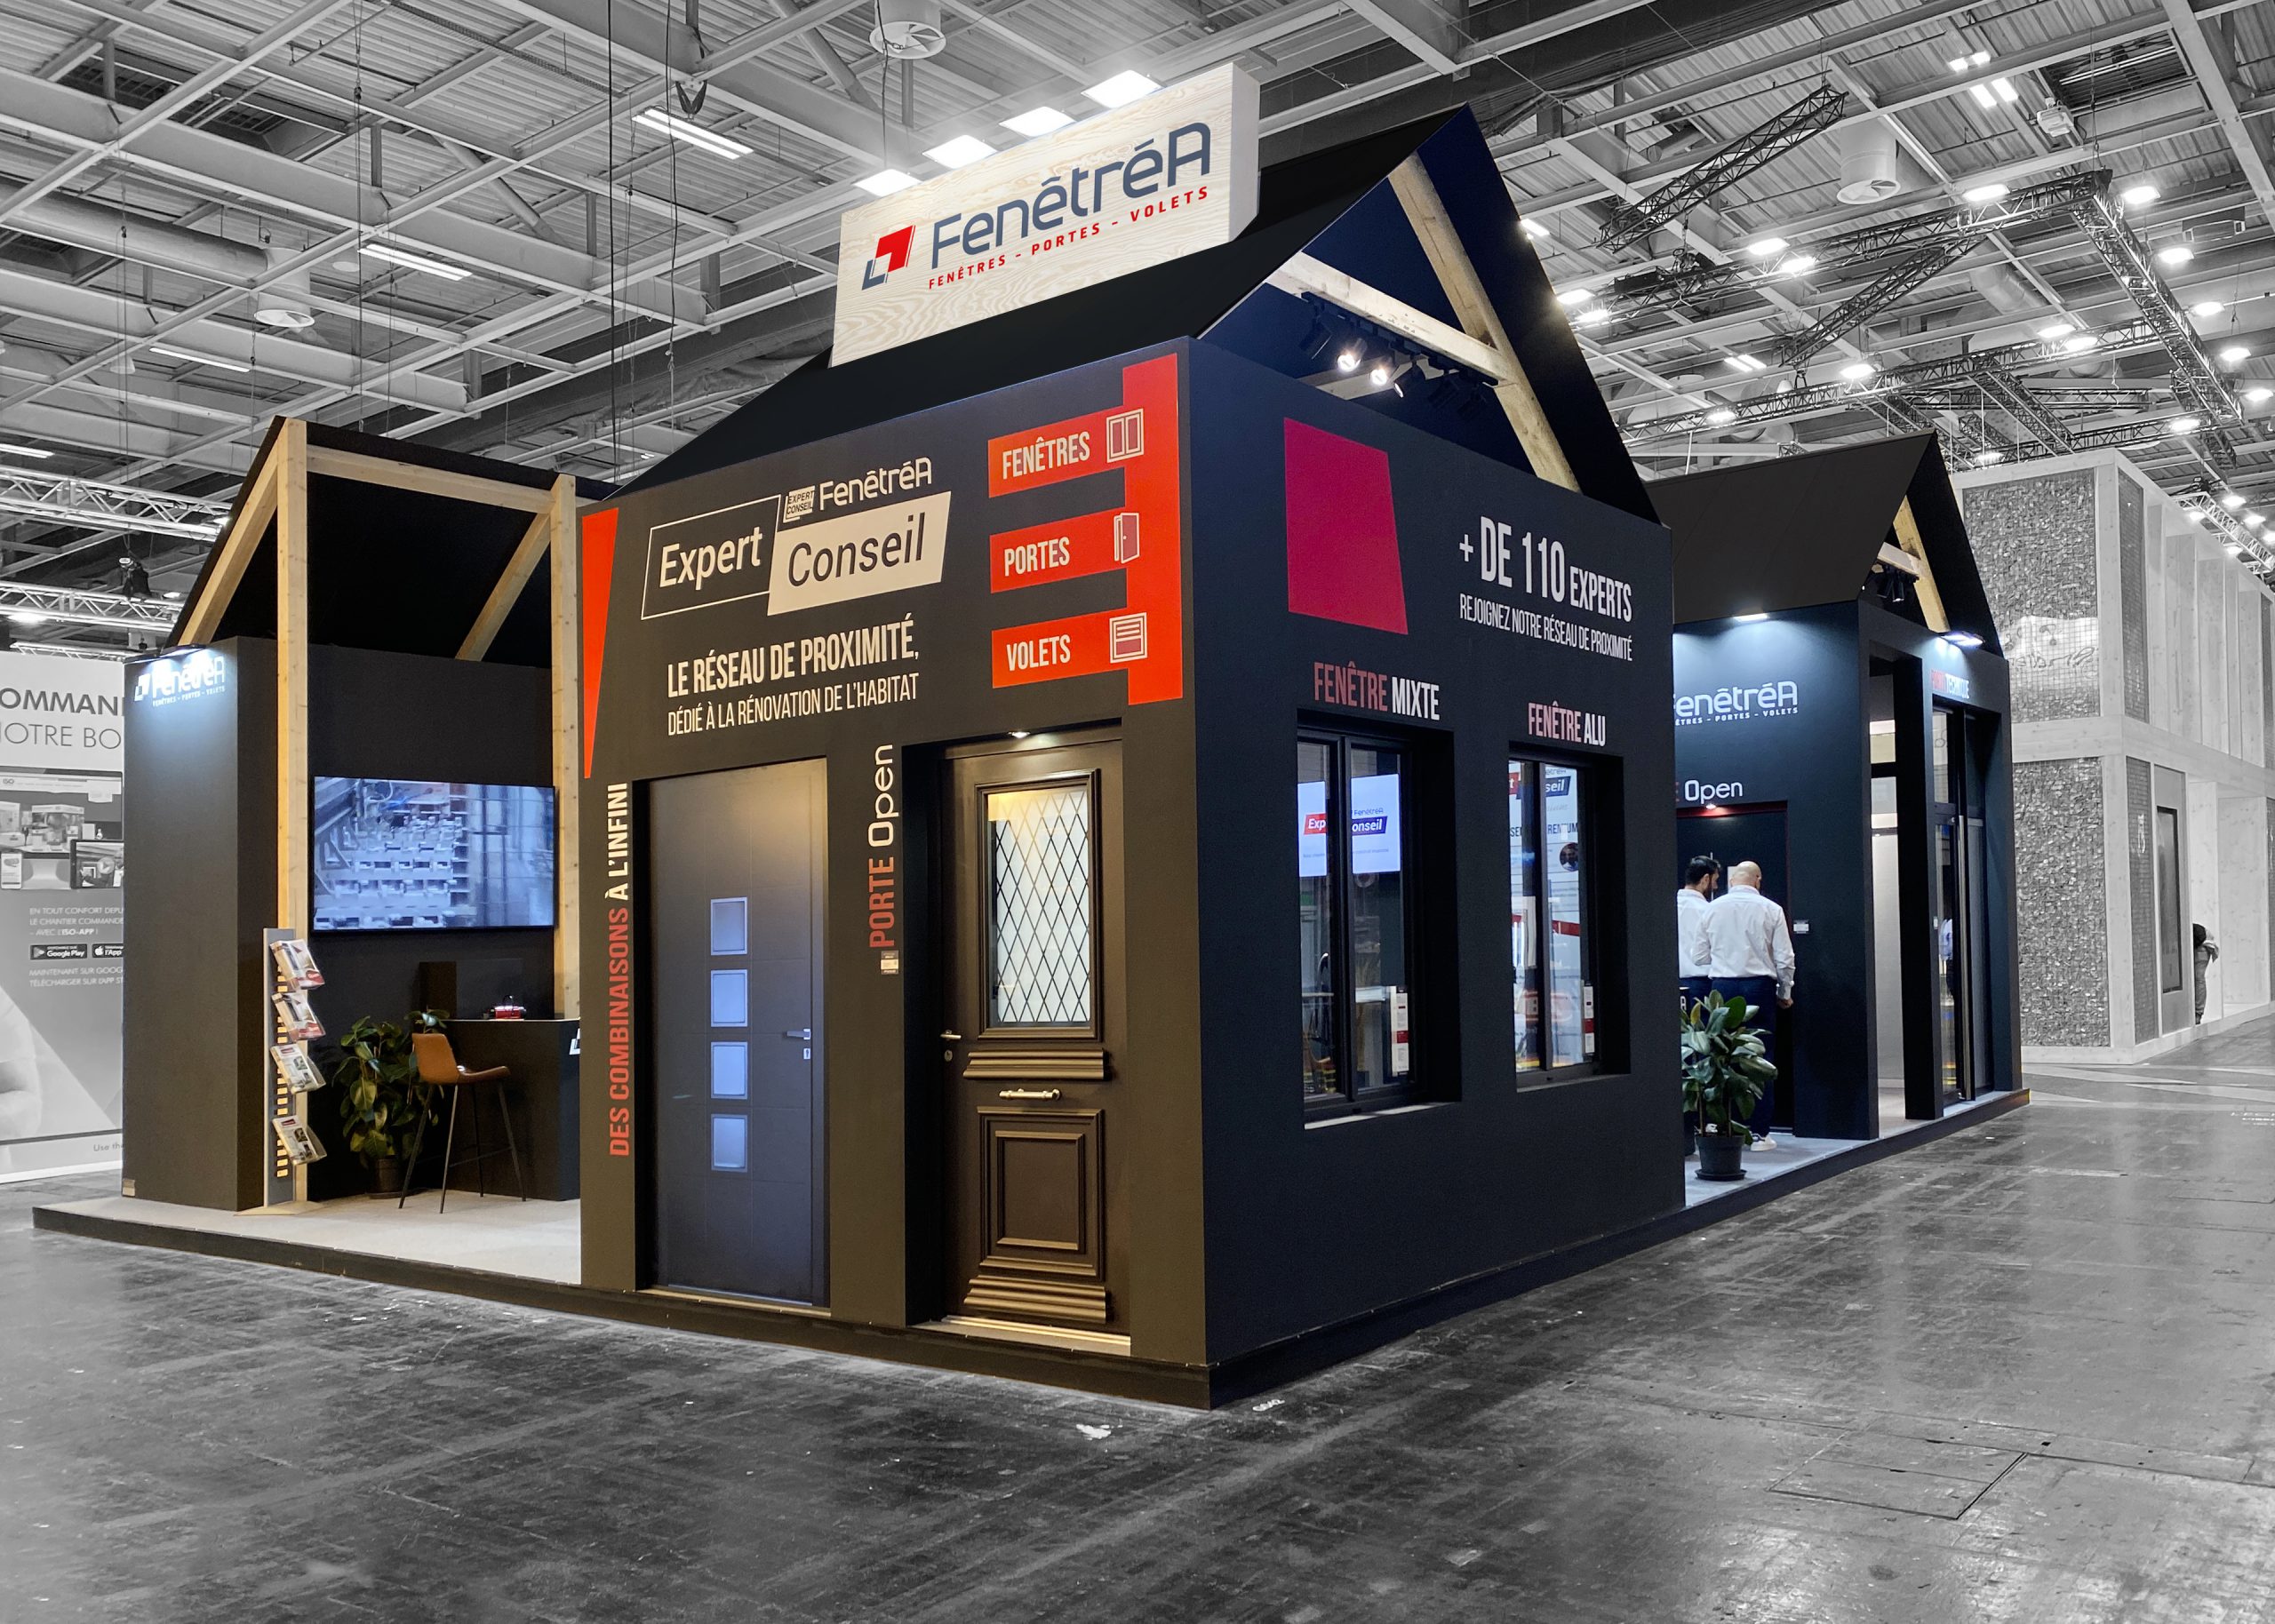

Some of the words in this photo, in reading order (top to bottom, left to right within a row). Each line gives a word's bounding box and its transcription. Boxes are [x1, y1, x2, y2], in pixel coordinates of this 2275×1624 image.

[931, 122, 1210, 270] FenêtréA
[929, 254, 1007, 289] FENÊTRES
[1031, 223, 1100, 256] PORTES
[1130, 186, 1209, 223] VOLETS
[1002, 432, 1090, 480] FENÊTRES
[786, 501, 813, 514] CONSEIL
[788, 490, 814, 505] EXPERT
[819, 457, 932, 511] FenêtréA
[659, 526, 762, 590] Expert
[788, 512, 926, 586] Conseil
[1004, 537, 1070, 576] PORTES
[1459, 534, 1473, 562] +
[1481, 515, 1513, 588] DE
[1522, 531, 1564, 602] 110
[1570, 566, 1632, 622] EXPERTS
[1459, 593, 1511, 631] REJOIGNEZ
[1512, 608, 1542, 639] NOTRE
[1544, 614, 1577, 648] RÉSEAU
[1579, 625, 1590, 650] DE
[1591, 629, 1632, 661] PROXIMITÉ
[668, 661, 689, 698] LE
[694, 647, 764, 694] RÉSEAU
[770, 641, 795, 681] DE
[801, 613, 919, 675] PROXIMITÉ,
[1006, 634, 1072, 673] VOLETS
[0, 688, 124, 716] OMMAN
[668, 703, 703, 736] DÉDIÉ
[706, 701, 715, 730] À
[718, 702, 735, 728] LA
[738, 689, 821, 725] RÉNOVATION
[824, 685, 842, 712] DE
[1314, 661, 1387, 712] FENÊTRE
[1392, 676, 1441, 720] MIXTE
[1673, 681, 1798, 717] enêtréA
[1715, 712, 1750, 722] PORTES
[1762, 707, 1799, 717] VOLETS
[0, 721, 72, 747] OTRE
[1529, 701, 1582, 743] FENÊTRE
[1583, 715, 1606, 747] ALU
[867, 744, 899, 848] Open
[1684, 780, 1744, 804] Open
[605, 883, 628, 901] À
[869, 856, 895, 948] PORTE
[608, 907, 629, 1100] COMBINAISONS
[609, 1105, 629, 1156] DES
